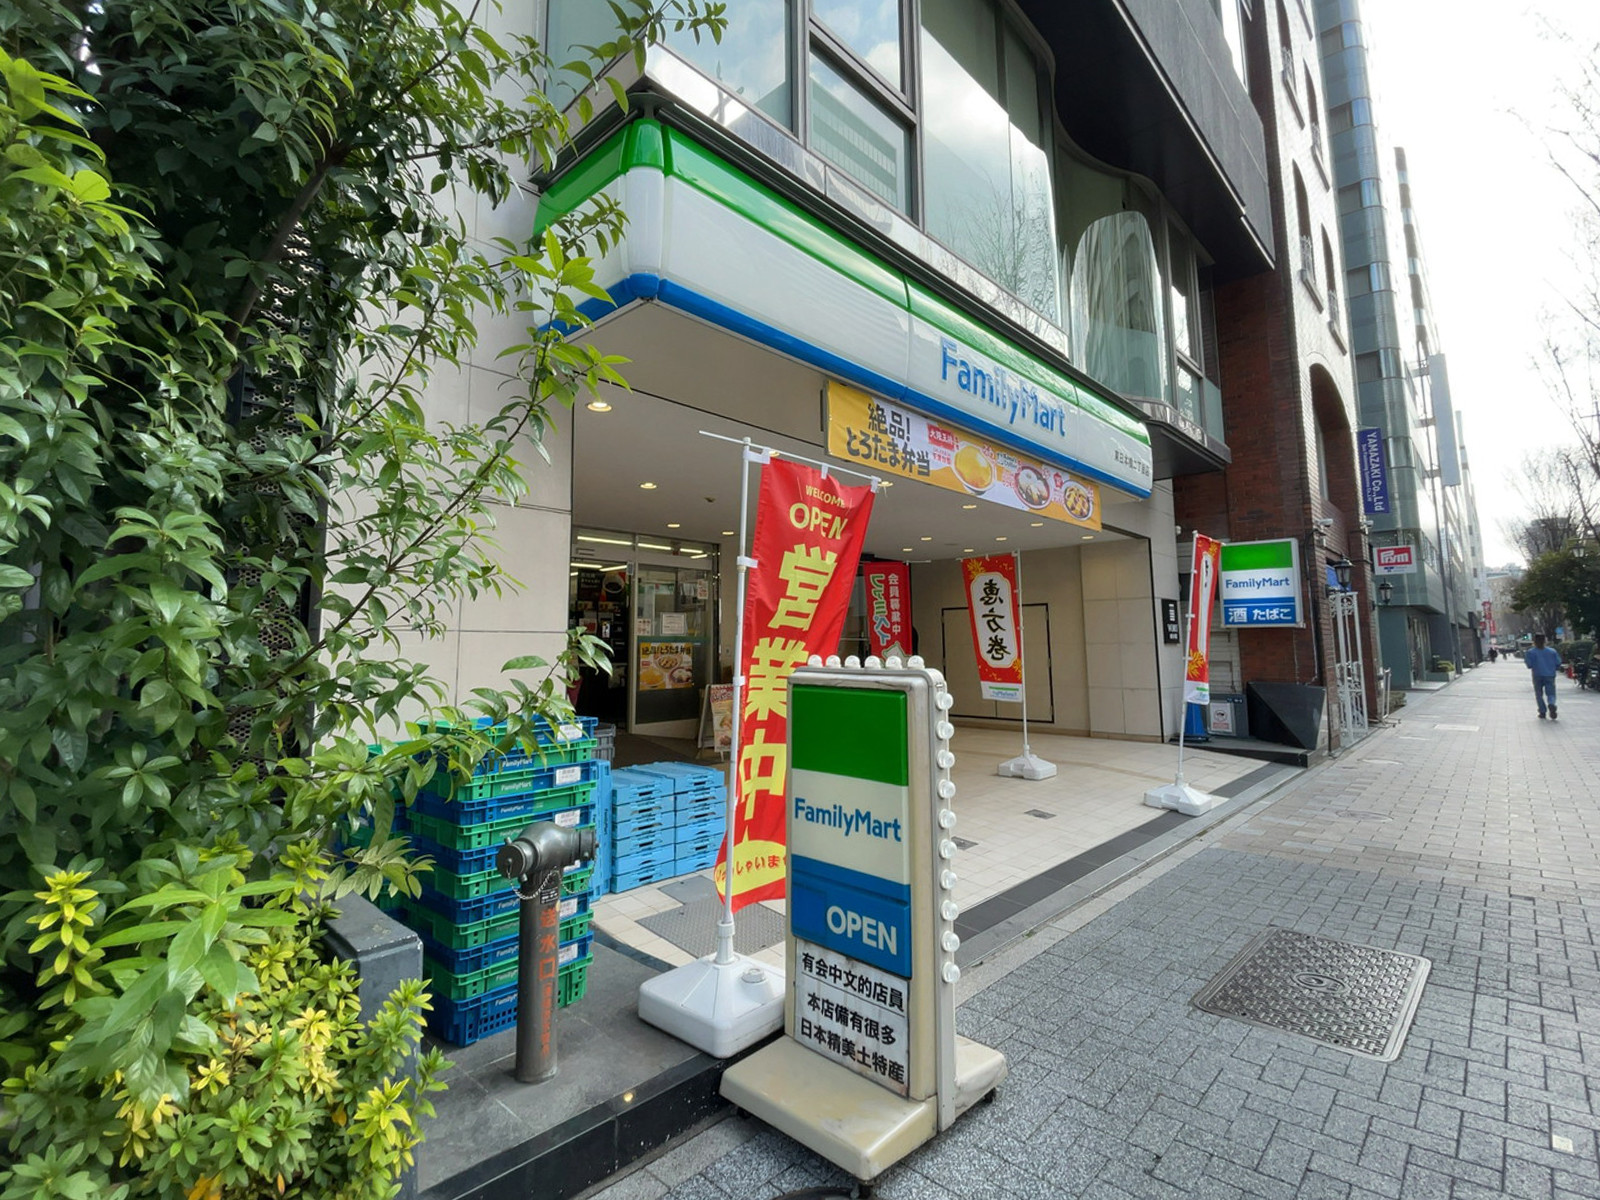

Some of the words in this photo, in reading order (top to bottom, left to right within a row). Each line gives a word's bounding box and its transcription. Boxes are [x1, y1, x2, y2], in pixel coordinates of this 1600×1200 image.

[940, 337, 1065, 437] FamilyMart
[867, 403, 911, 442] 絶品!
[846, 427, 931, 477] とろたま弁当
[1367, 431, 1381, 478] YAMAZAKI
[790, 502, 848, 540] OPEN
[805, 484, 847, 509] WELCOME
[1225, 577, 1290, 589] FamilyMart
[1228, 607, 1248, 623] 酒
[1252, 607, 1292, 621] たばこ
[739, 543, 838, 821] 営業中
[794, 797, 902, 844] FamilyMart
[539, 908, 557, 980] 送水口
[826, 906, 898, 956] OPEN
[801, 952, 905, 1013] 有会中文的店員
[807, 991, 897, 1046] 本店備有很多
[800, 1019, 905, 1085] 日本精美土特産
